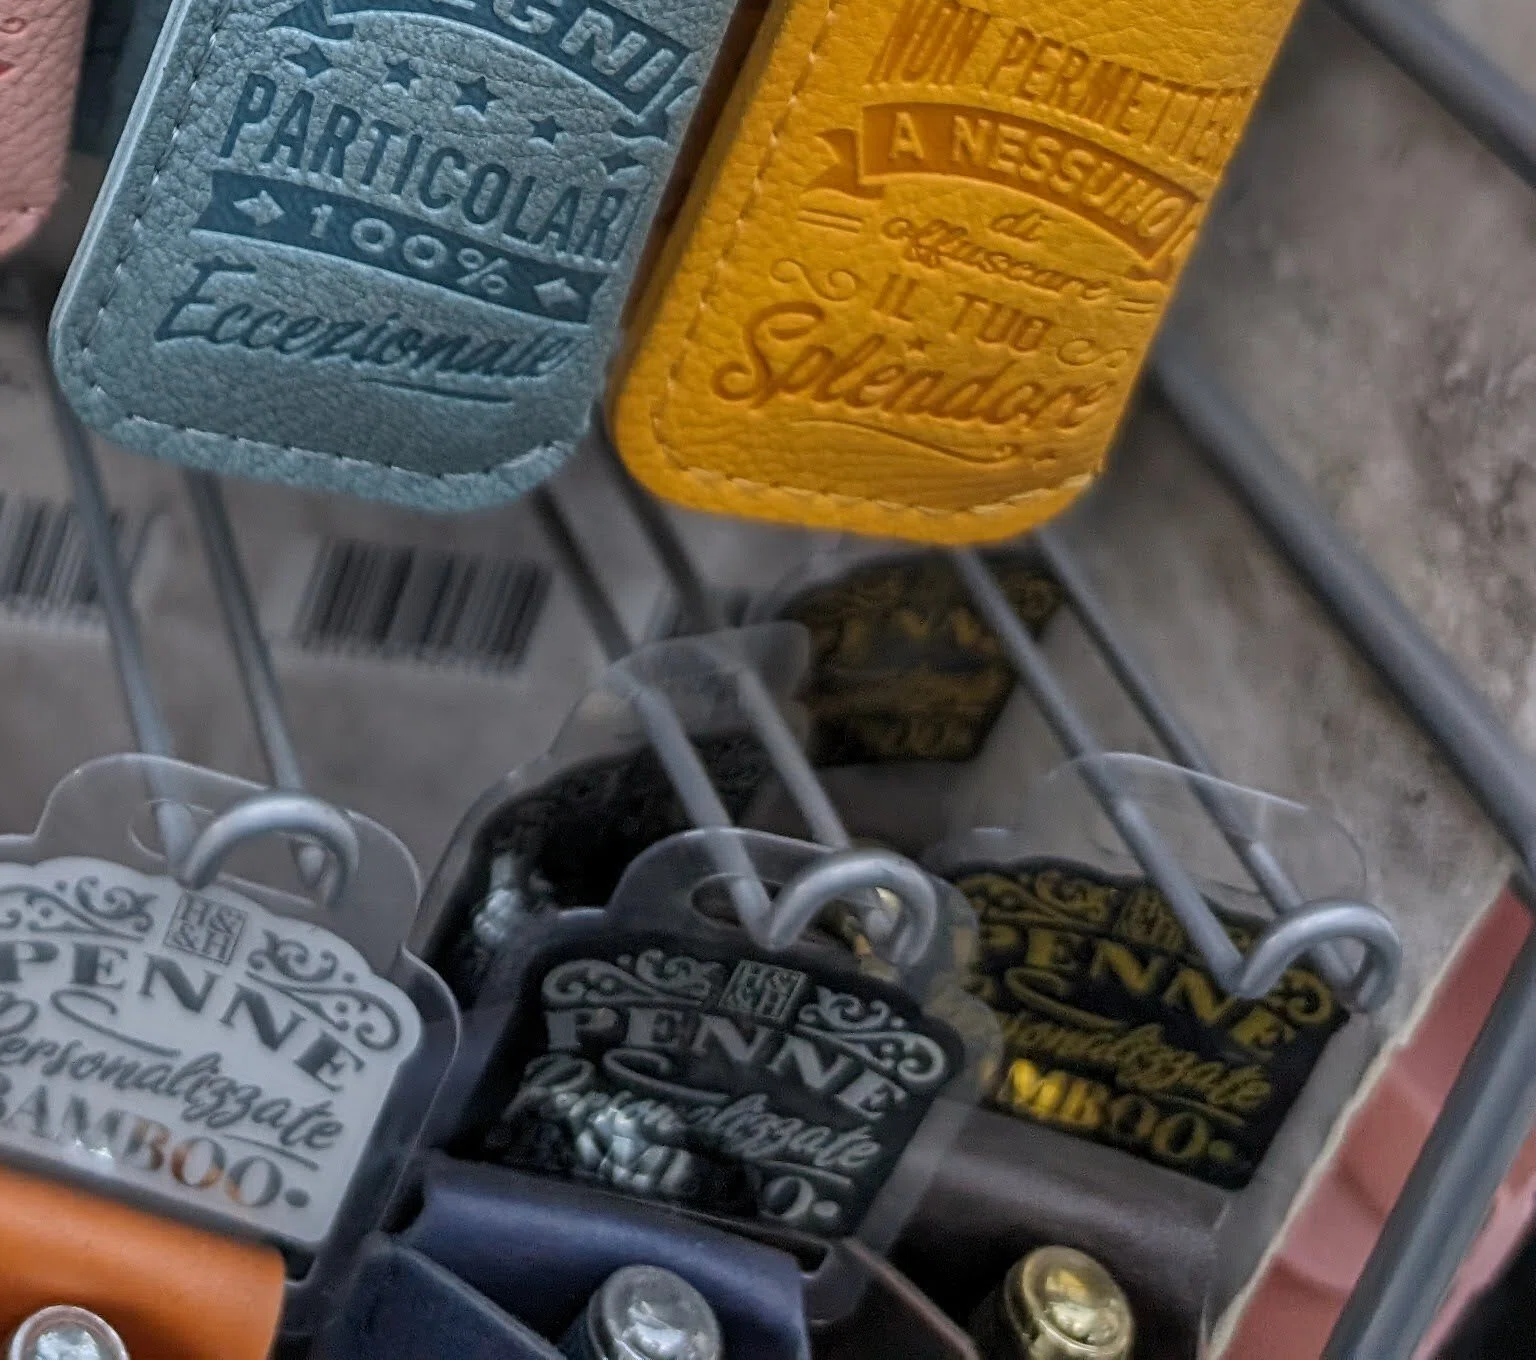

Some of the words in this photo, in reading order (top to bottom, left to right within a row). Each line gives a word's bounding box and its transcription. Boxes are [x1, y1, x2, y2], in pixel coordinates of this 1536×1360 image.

[888, 111, 925, 161] A
[951, 114, 1188, 238] NESSUNO
[310, 202, 510, 297] 100%
[986, 208, 1053, 242] di
[872, 273, 918, 322] IL
[947, 292, 1055, 353] TUO
[544, 1006, 908, 1120] PENNE
